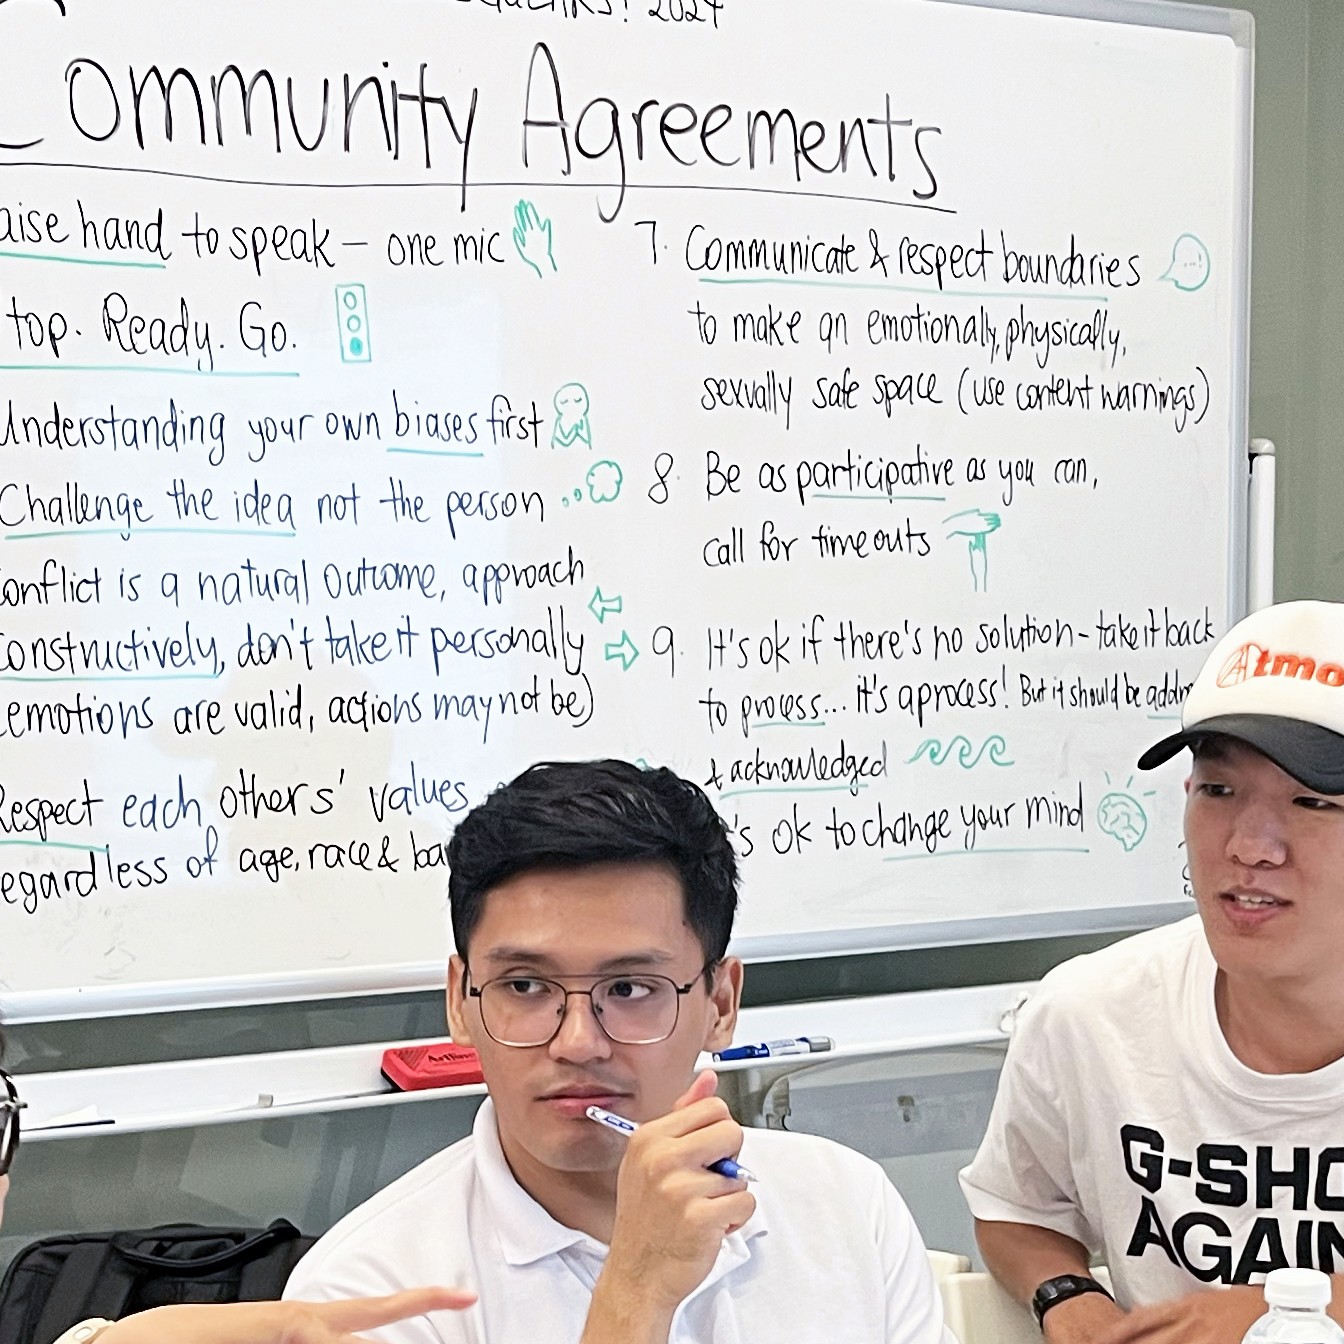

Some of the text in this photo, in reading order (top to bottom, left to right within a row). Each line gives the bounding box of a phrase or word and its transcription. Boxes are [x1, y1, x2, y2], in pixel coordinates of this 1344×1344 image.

[520, 42, 944, 224] Agreements
[77, 199, 172, 260] hand
[181, 212, 218, 258] to
[229, 218, 335, 277] speak
[388, 233, 444, 266] one
[454, 228, 505, 265] mic
[686, 225, 1140, 291] Communicate & respect boundaries
[102, 292, 224, 372] Ready.
[240, 301, 296, 358] Go.
[687, 300, 1126, 369] to make an emotionally, physically,
[248, 415, 314, 463] your
[326, 412, 381, 441] own
[393, 389, 477, 444] biases
[486, 394, 544, 448] first
[812, 367, 859, 409] safe
[872, 373, 943, 418] space
[958, 367, 1004, 415] (use
[1016, 374, 1093, 411] content
[1101, 367, 1209, 433] warnings)
[166, 479, 219, 520] the
[234, 479, 296, 530] idea
[318, 483, 360, 525] not
[379, 476, 430, 522] the
[447, 491, 544, 540] person
[707, 444, 1097, 506] Be as participative as you can,
[759, 521, 798, 561] for
[120, 573, 141, 601] is
[161, 573, 179, 608] a
[199, 558, 309, 605] natural
[463, 545, 584, 606] approach
[238, 605, 584, 676] don't take personally
[708, 606, 1215, 673] It's ok if there's no solution take it back
[174, 700, 225, 735] are
[235, 683, 313, 733] valid,
[329, 691, 421, 732] actions
[434, 694, 492, 744] may
[499, 674, 541, 715] not
[551, 671, 593, 728] be)
[699, 687, 727, 734] to
[857, 673, 888, 714] it's
[918, 664, 1008, 728] process!
[1020, 673, 1047, 707] But
[1070, 673, 1118, 710] should
[123, 774, 201, 832] each
[220, 768, 344, 819] others'
[369, 761, 468, 823] values
[728, 739, 887, 797] acknowledged
[772, 781, 1083, 854] ok to change your mind
[186, 825, 218, 878] of
[240, 847, 299, 883] age,
[308, 840, 373, 871] race
